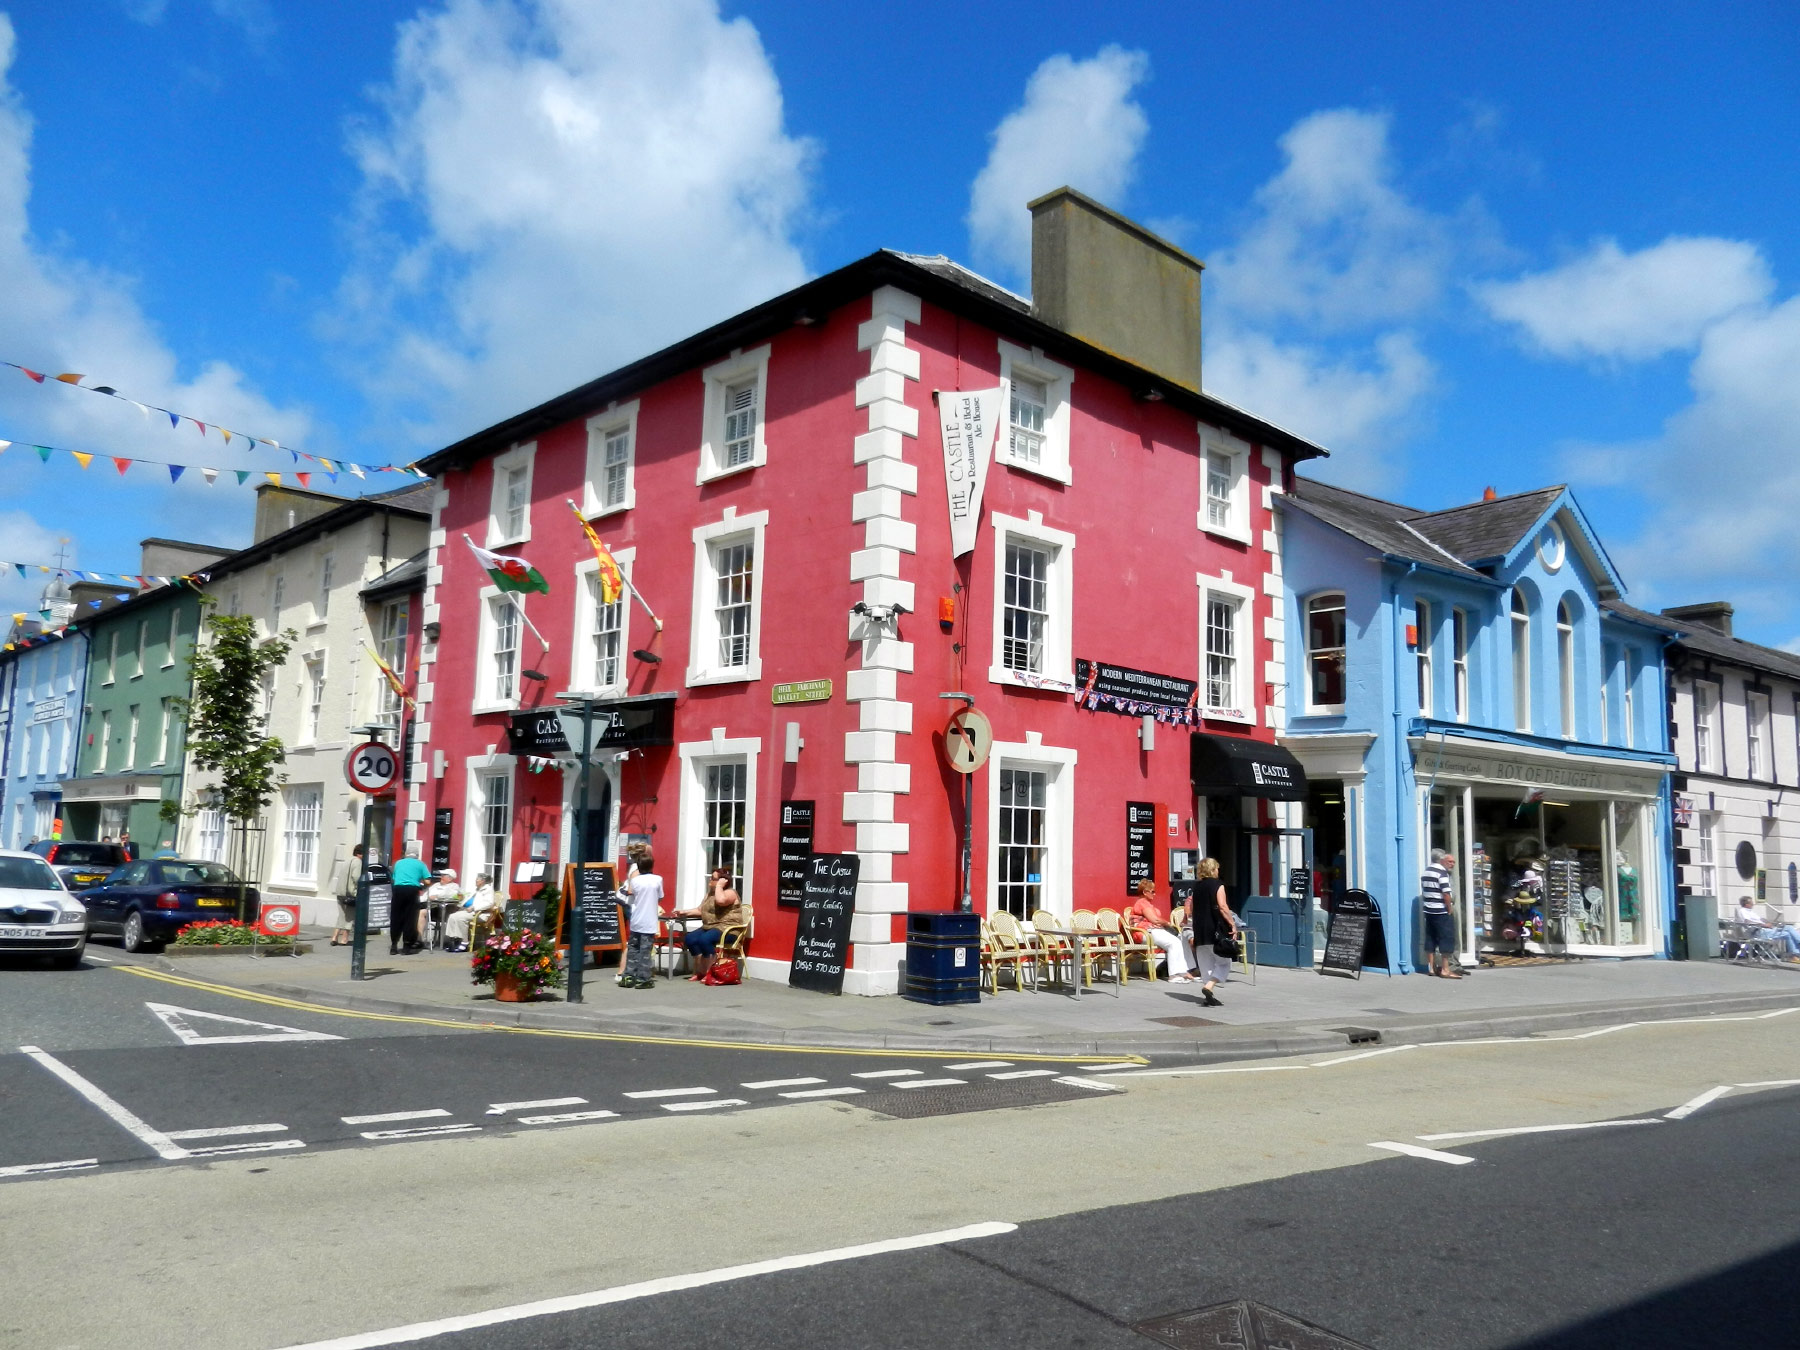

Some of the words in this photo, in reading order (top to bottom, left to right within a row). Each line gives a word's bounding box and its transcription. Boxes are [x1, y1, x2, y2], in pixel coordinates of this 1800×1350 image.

[962, 398, 971, 420] Hotel
[973, 397, 981, 421] House
[946, 422, 964, 482] CASTLE
[967, 434, 976, 477] Restaurant
[951, 490, 967, 521] THE
[1098, 682, 1111, 691] using
[1131, 689, 1149, 697] produce
[1102, 668, 1123, 680] MODERN
[1124, 672, 1162, 688] MEDITERRANEAN
[1162, 679, 1190, 693] RESTAURANT
[358, 756, 393, 777] 20
[1261, 764, 1290, 778] CASTLE
[1496, 763, 1522, 779] BOX
[1525, 766, 1542, 781] OF
[1545, 769, 1602, 788] DELIGHTS
[782, 836, 810, 844] Restaurant
[810, 916, 816, 929] 6
[827, 916, 833, 929] 9
